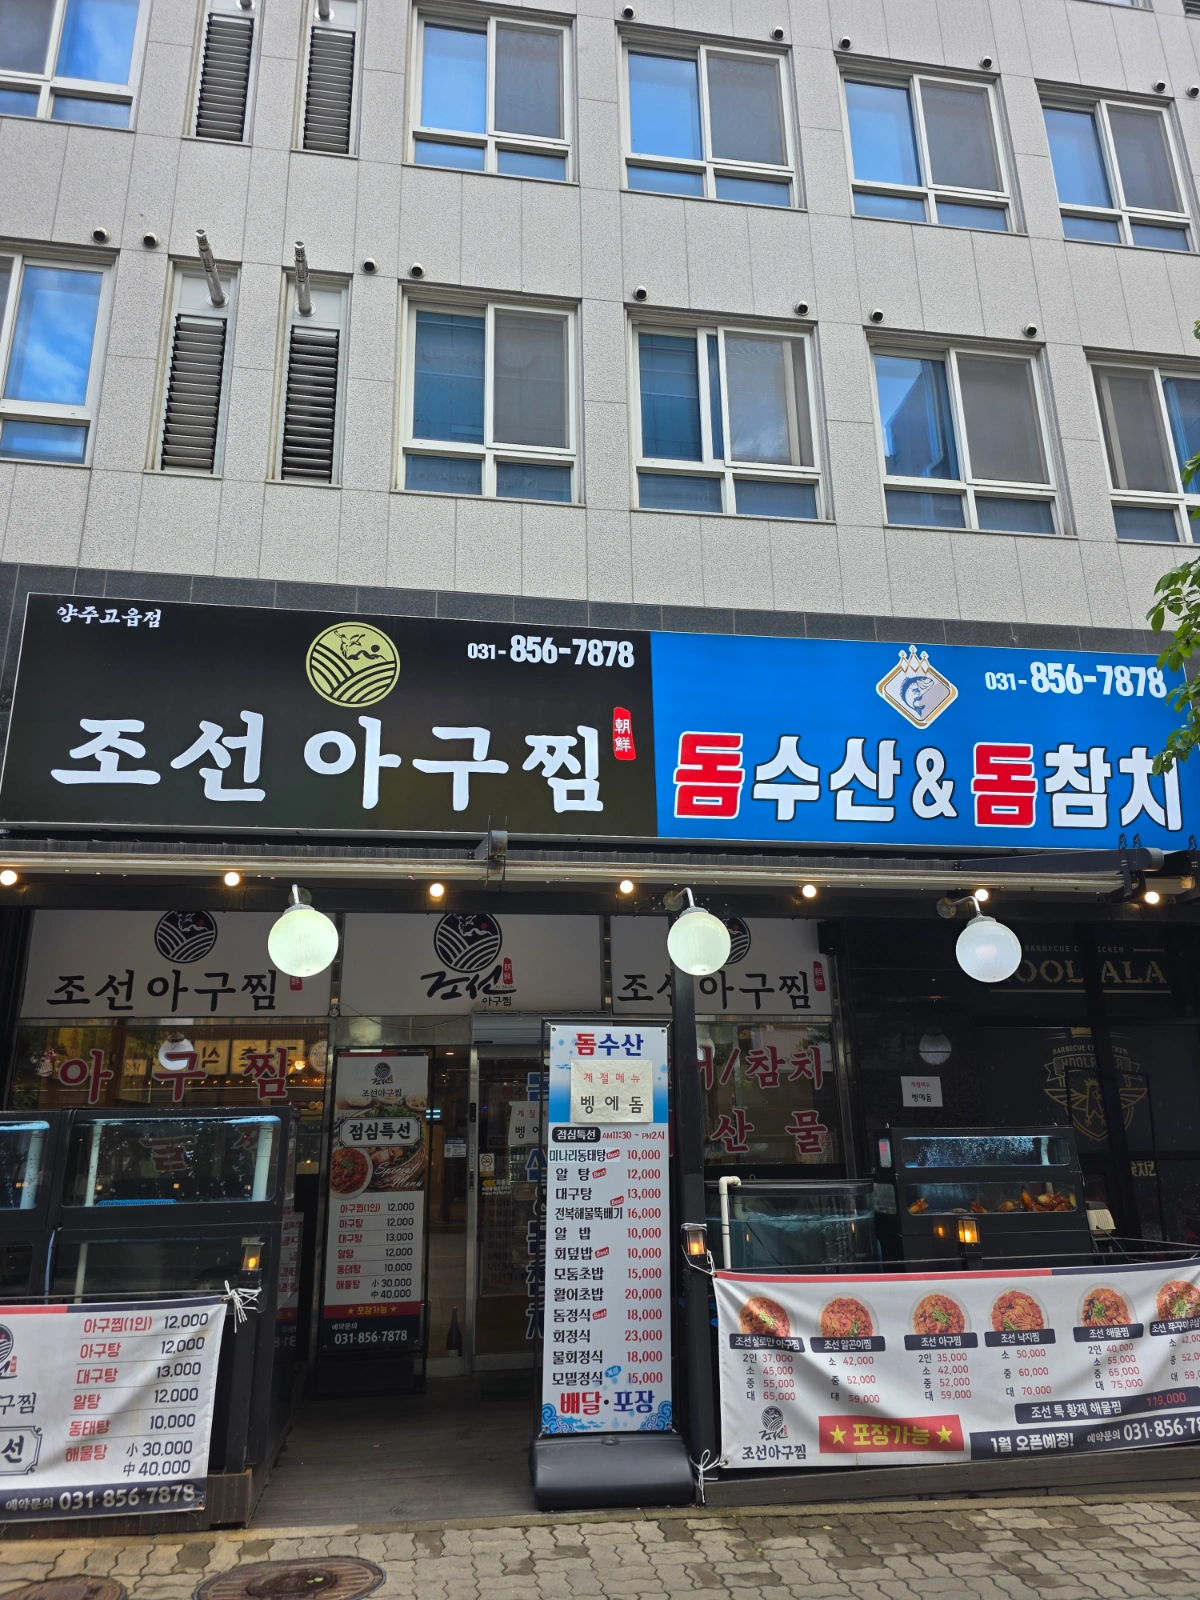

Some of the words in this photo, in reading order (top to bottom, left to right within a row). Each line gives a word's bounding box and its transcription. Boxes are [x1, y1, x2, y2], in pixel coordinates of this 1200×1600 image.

[57, 604, 162, 628] 양주고읍점
[1024, 944, 1072, 953] BARBECUE
[482, 996, 512, 1006] 아구찜
[575, 1033, 644, 1056] 돔수산
[1053, 1045, 1087, 1055] BARBECUE
[361, 1088, 402, 1097] 조선아구찜
[348, 1121, 411, 1141] 점심특선
[557, 1129, 595, 1140] 점심특선
[549, 1149, 606, 1162] 미나리동태탕
[627, 1149, 661, 1161] 10,000
[627, 1168, 661, 1180] 12,000
[555, 1187, 592, 1201] 대구탕
[627, 1188, 661, 1200] 13,000
[340, 1203, 380, 1213] 아구찜(1인)
[555, 1207, 623, 1221] 전복해물뚝배기
[627, 1208, 662, 1220] 16,000
[339, 1219, 363, 1228] 아구탕
[338, 1233, 363, 1244] 대구탕
[627, 1228, 662, 1240] 10,000
[338, 1249, 354, 1259] 알탕
[554, 1247, 593, 1261] 회덮밥
[627, 1247, 662, 1260] 10,000
[337, 1264, 361, 1274] 동태탕
[554, 1267, 604, 1281] 모둠초밥
[627, 1268, 662, 1280] 15,000
[336, 1280, 360, 1290] 해물탕
[553, 1287, 604, 1301] 활어초밥
[624, 1288, 662, 1301] 20,000
[357, 1306, 388, 1315] 포장가능
[553, 1308, 591, 1323] 돔정식
[627, 1308, 662, 1321] 18,000
[83, 1315, 153, 1334] 아구찜(1인)
[332, 1322, 358, 1330] 예약문의
[553, 1329, 591, 1344] 회정식
[624, 1329, 662, 1342] 23,000
[1169, 1338, 1177, 1347] 소
[80, 1342, 121, 1359] 아구탕
[1001, 1350, 1010, 1360] 소
[1088, 1345, 1102, 1355] 2인
[552, 1350, 603, 1365] 물회정식
[627, 1350, 663, 1363] 18,000
[743, 1353, 757, 1364] 2인
[828, 1357, 837, 1366] 소
[918, 1354, 932, 1364] 2인
[76, 1367, 119, 1385] 대구탕
[746, 1367, 755, 1375] 소
[922, 1366, 931, 1376] 소
[1003, 1369, 1012, 1379] 중
[1094, 1368, 1102, 1379] 중
[552, 1371, 603, 1386] 모밀정식
[627, 1371, 663, 1385] 15,000
[831, 1375, 840, 1387] 중
[1171, 1372, 1178, 1382] 대
[746, 1377, 755, 1389] 중
[923, 1379, 932, 1389] 중
[1095, 1380, 1104, 1391] 대
[746, 1390, 755, 1401] 대
[831, 1392, 840, 1401] 대
[924, 1391, 933, 1402] 대
[1005, 1387, 1015, 1397] 대
[73, 1393, 101, 1410] 알탕
[1031, 1405, 1051, 1419] 조선
[1053, 1403, 1065, 1418] 특
[1066, 1402, 1089, 1417] 황제
[1090, 1400, 1122, 1415] 해물찜
[69, 1419, 111, 1437] 동태탕
[852, 1423, 931, 1446] 포장가능
[990, 1436, 1012, 1452] 1월
[1016, 1433, 1075, 1451] 오픈예정!
[1087, 1430, 1121, 1443] 예약문의
[1, 1434, 24, 1463] 선
[65, 1444, 109, 1463] 해물탕
[742, 1444, 806, 1460] 조선아구찜
[5, 1497, 54, 1511] 예약문의
